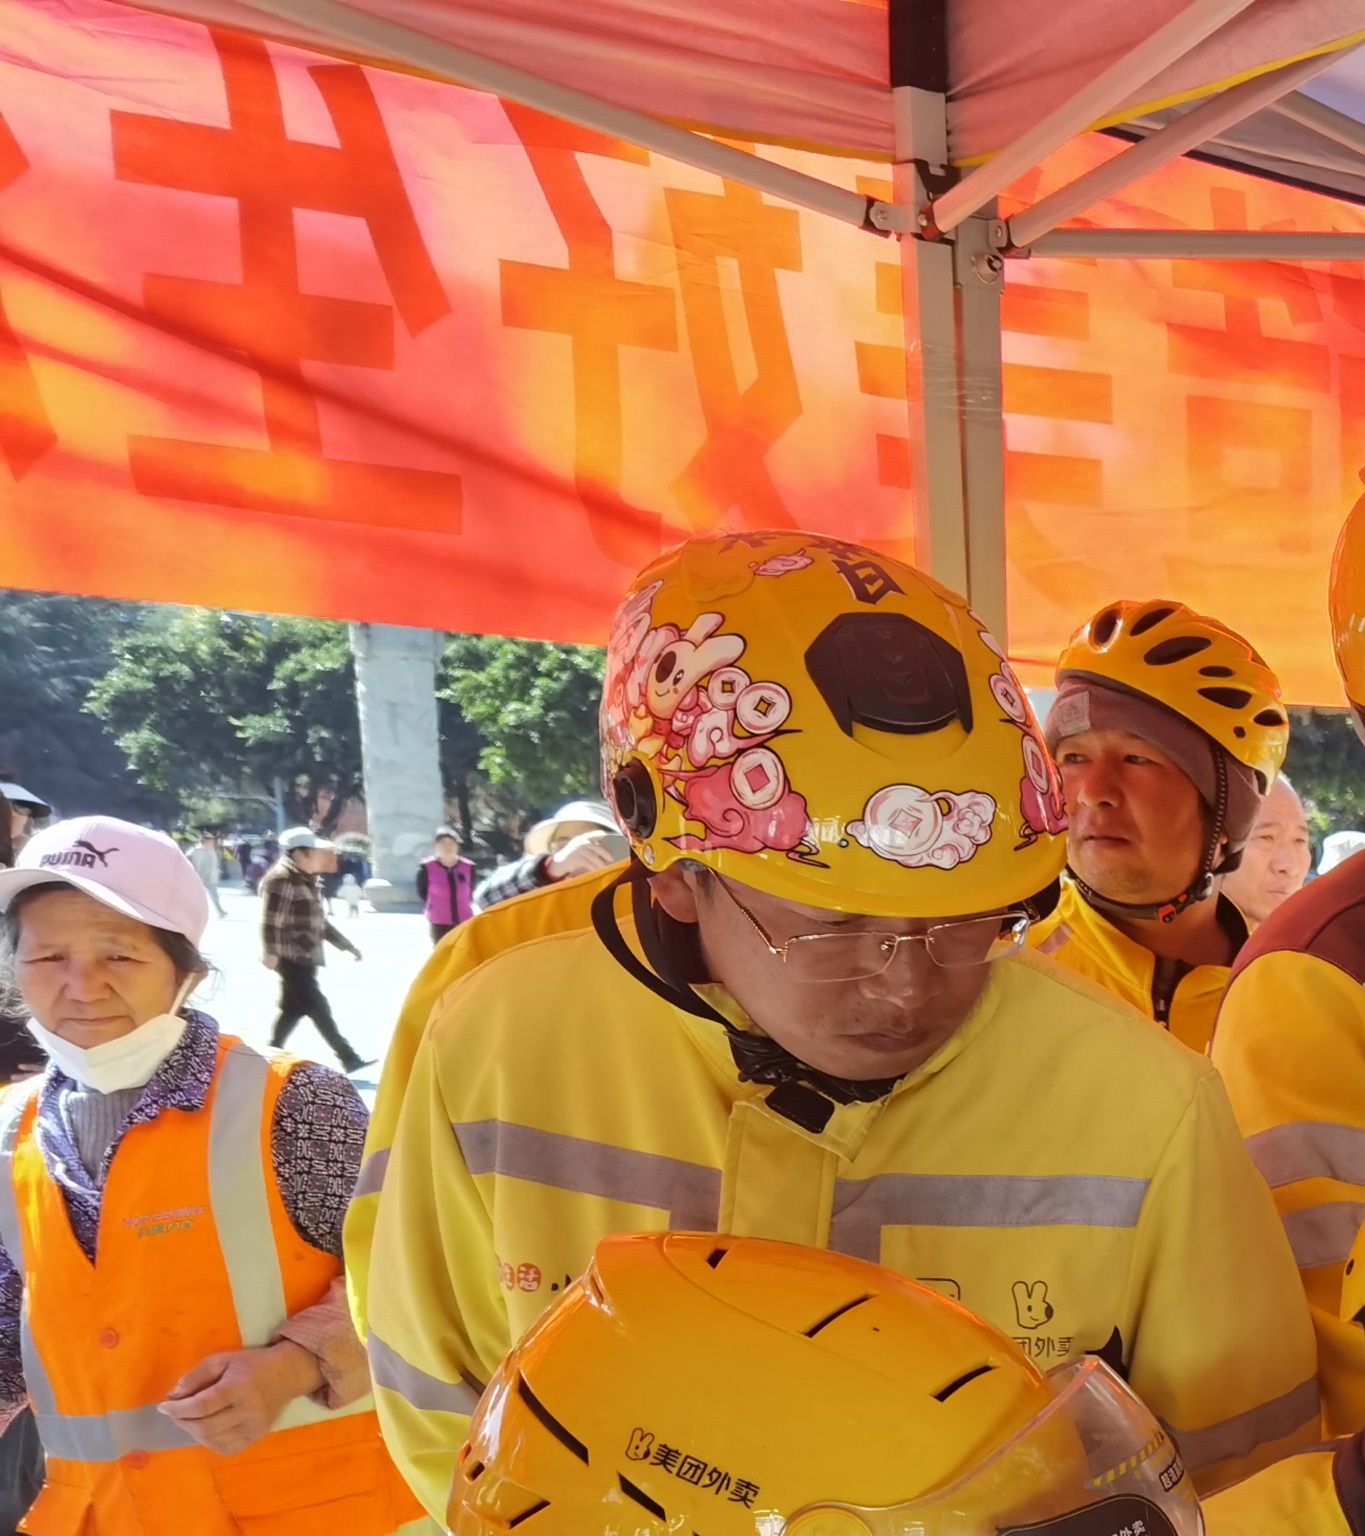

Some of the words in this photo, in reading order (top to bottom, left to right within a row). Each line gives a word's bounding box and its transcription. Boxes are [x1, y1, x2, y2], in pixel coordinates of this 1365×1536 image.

[40, 850, 97, 869] PUMA
[648, 1441, 762, 1509] 美团外卖
